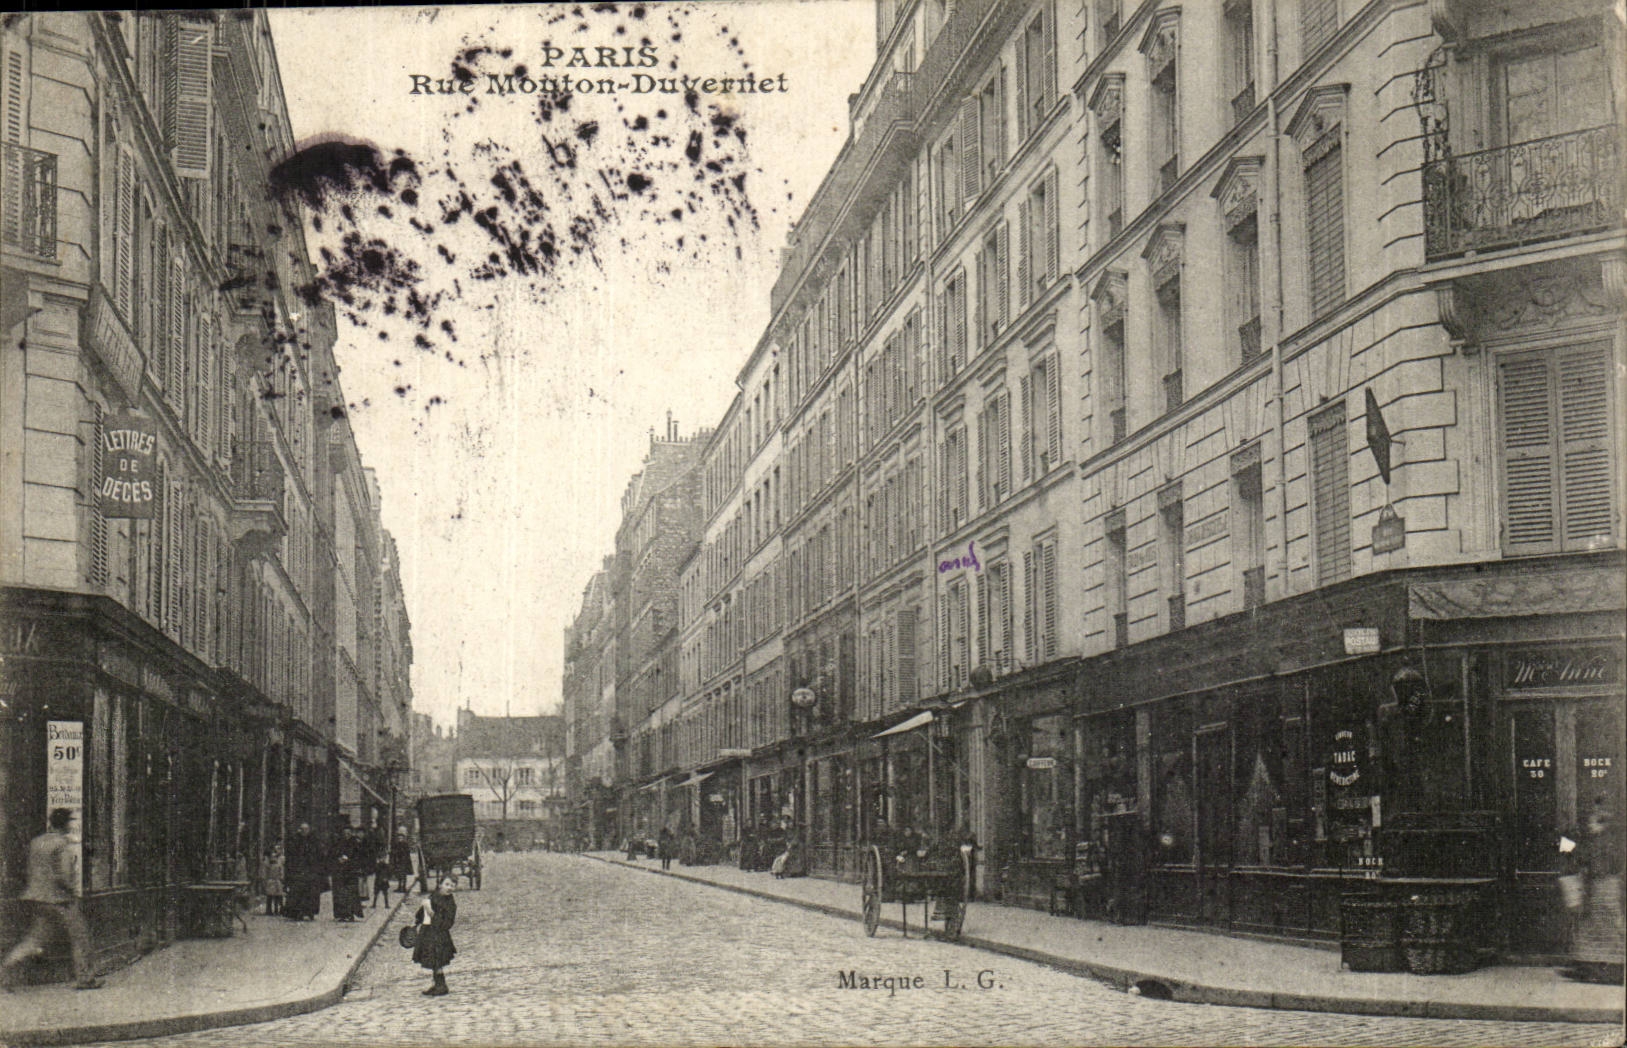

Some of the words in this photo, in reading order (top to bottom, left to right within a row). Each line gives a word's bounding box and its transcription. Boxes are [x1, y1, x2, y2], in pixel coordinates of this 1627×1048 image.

[103, 429, 155, 455] LETTRES
[120, 458, 139, 472] DE
[1333, 750, 1356, 764] TABAC
[1583, 758, 1612, 767] BOCK
